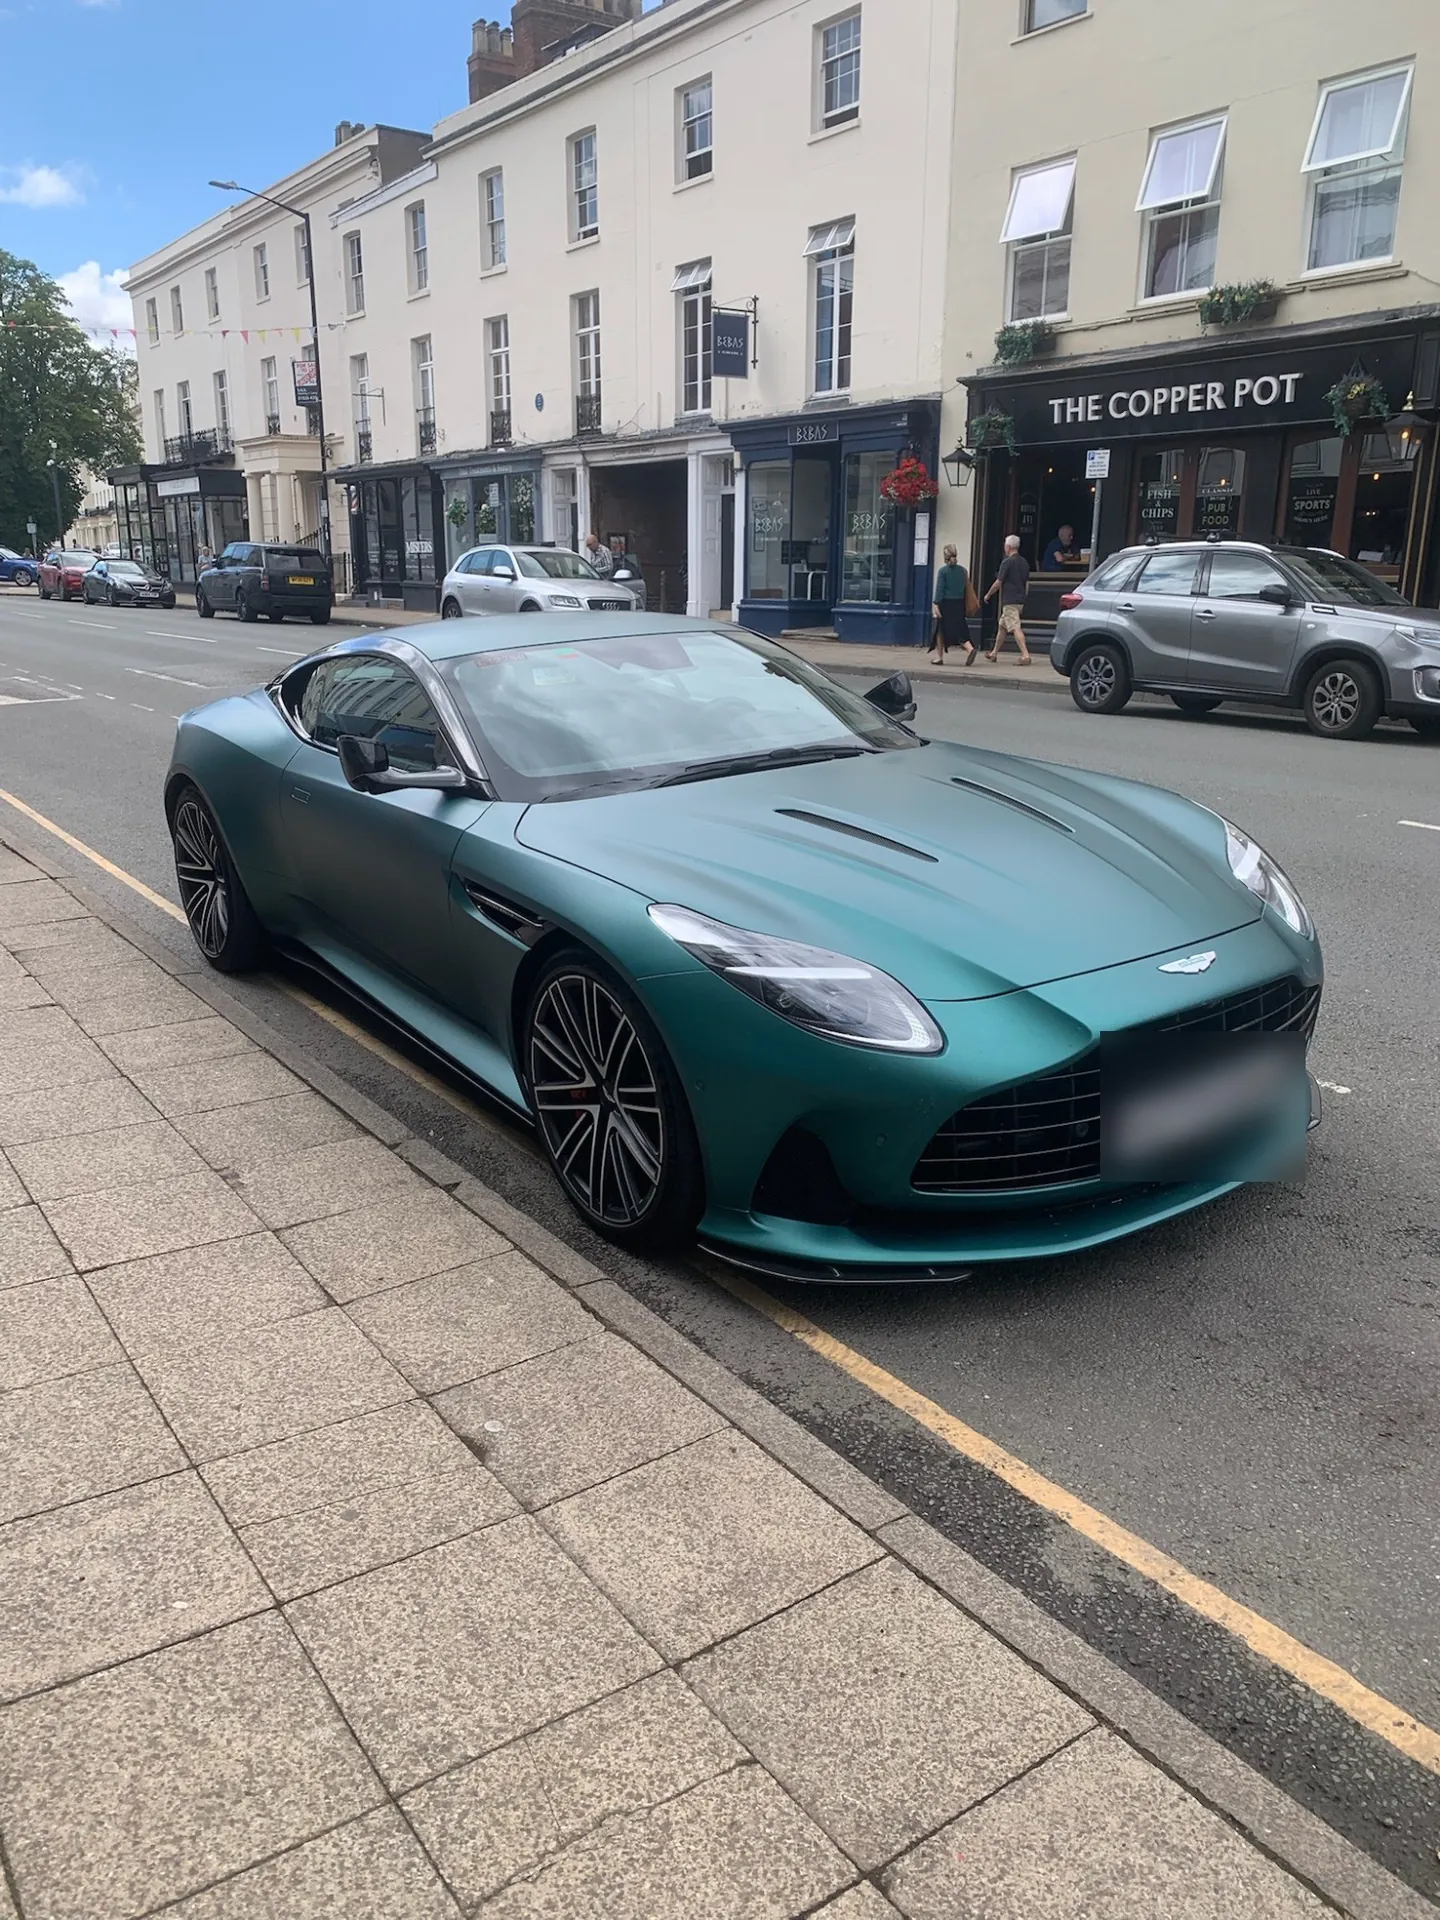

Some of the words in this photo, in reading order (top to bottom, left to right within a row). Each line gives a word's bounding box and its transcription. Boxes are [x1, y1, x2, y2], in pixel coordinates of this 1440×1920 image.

[717, 335, 744, 349] BEBAS
[1048, 394, 1104, 425] THE
[1108, 381, 1227, 419] COPPER
[1233, 372, 1304, 409] POT
[796, 425, 828, 442] BEBAS
[1147, 489, 1173, 500] FISH
[1208, 503, 1226, 512] PUB
[1294, 500, 1330, 510] SPORTS
[1141, 507, 1175, 519] CHIPS
[755, 517, 784, 532] BEBAS
[853, 513, 887, 533] BEBAS
[1202, 515, 1229, 525] FOOD
